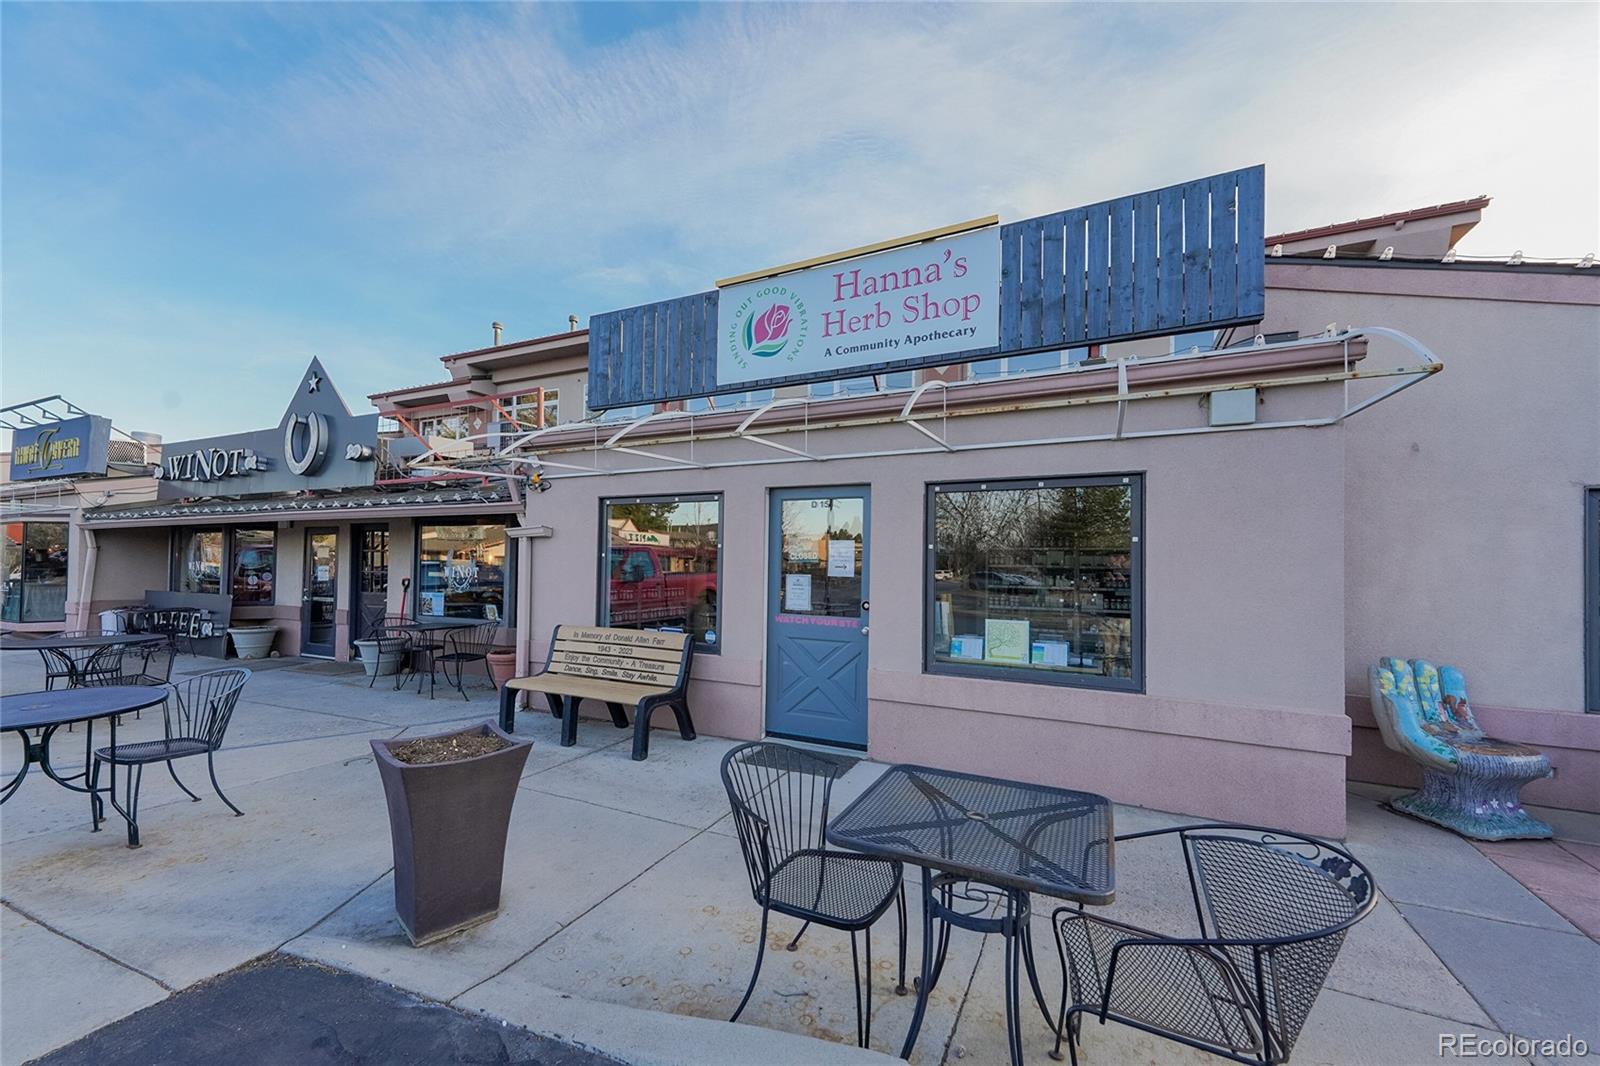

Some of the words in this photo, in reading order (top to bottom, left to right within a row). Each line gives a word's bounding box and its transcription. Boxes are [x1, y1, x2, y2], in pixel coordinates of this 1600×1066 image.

[832, 249, 968, 302] Hanna's
[756, 286, 787, 298] GOOD
[735, 297, 753, 318] OUT
[821, 301, 891, 338] Herb
[902, 292, 981, 324] Shop
[787, 292, 808, 362] VIBRATIONS
[728, 322, 748, 369] SENDING
[824, 348, 832, 358] A
[835, 338, 900, 356] Community
[904, 326, 977, 346] Apothecary
[168, 447, 244, 481] WINOT
[811, 500, 817, 508] D
[790, 552, 818, 560] CLOSED
[776, 615, 809, 624] WATCH
[810, 617, 838, 626] YOUR
[573, 630, 579, 638] In
[581, 631, 602, 641] Memory
[605, 632, 612, 640] of
[613, 633, 633, 643] Donald
[635, 635, 650, 644] Allen
[564, 653, 579, 663] Enjoy
[592, 655, 624, 667] Community
[631, 660, 636, 668] A
[639, 660, 665, 671] Treasure
[622, 670, 635, 680] Stay
